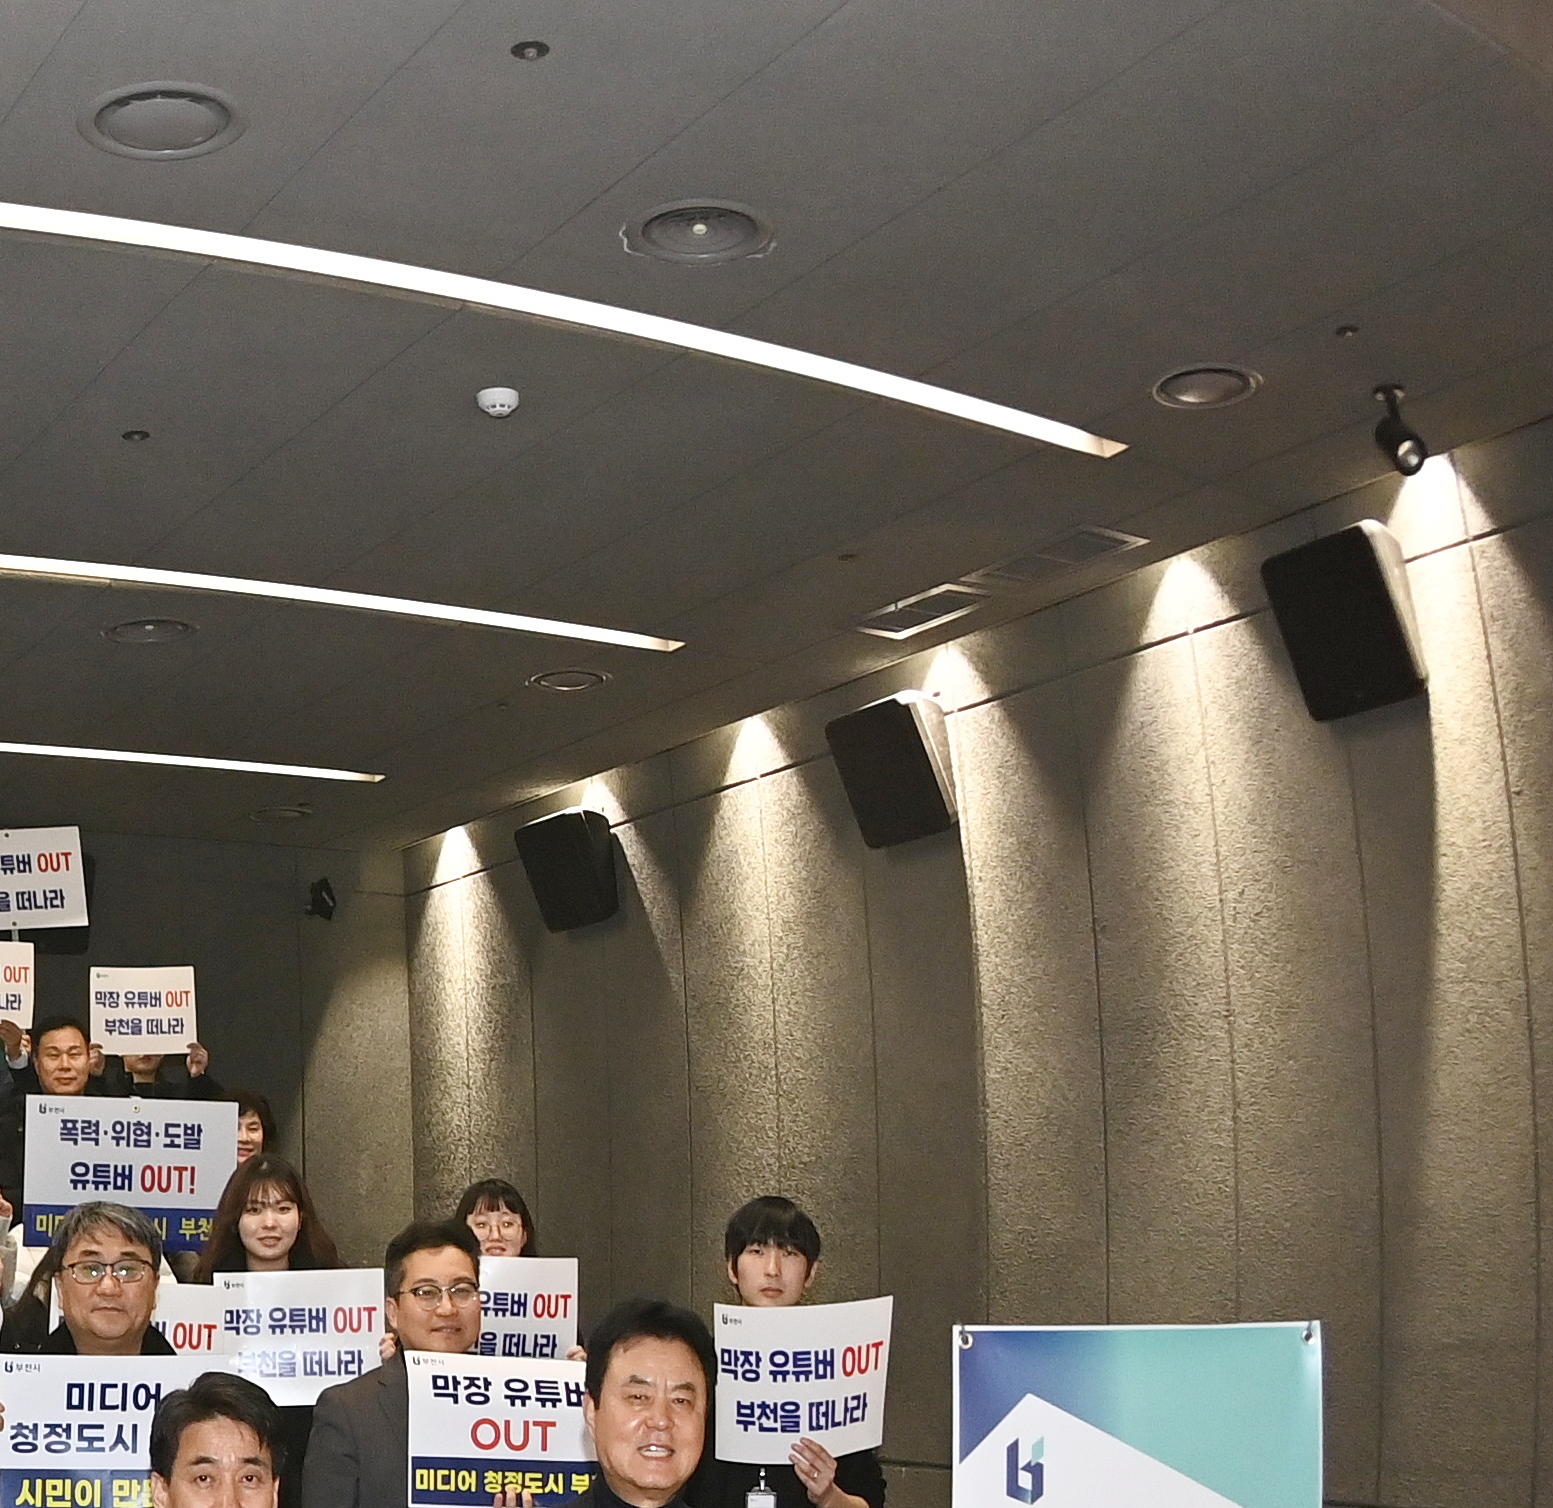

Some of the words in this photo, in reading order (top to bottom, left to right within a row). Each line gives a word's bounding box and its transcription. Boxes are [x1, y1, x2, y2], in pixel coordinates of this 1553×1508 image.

[37, 852, 72, 872] OUT
[16, 889, 65, 910] 떠나라
[95, 991, 120, 1008] 막장
[124, 991, 161, 1008] 유튜버
[166, 991, 190, 1007] OUT
[105, 1018, 142, 1035] 부천을
[147, 1018, 184, 1035] 떠나라
[60, 1119, 203, 1150] 폭력·위협·도발
[70, 1162, 132, 1191] 유튜버
[141, 1165, 195, 1194] OUT!
[721, 1348, 762, 1382] 막장
[769, 1348, 834, 1382] 유튜버
[842, 1341, 883, 1377] OUT
[432, 1375, 492, 1405] 막장
[736, 1401, 800, 1433] 부천을
[809, 1392, 867, 1431] 떠나라
[471, 1418, 556, 1451] OUT
[416, 1469, 476, 1491] 미디어
